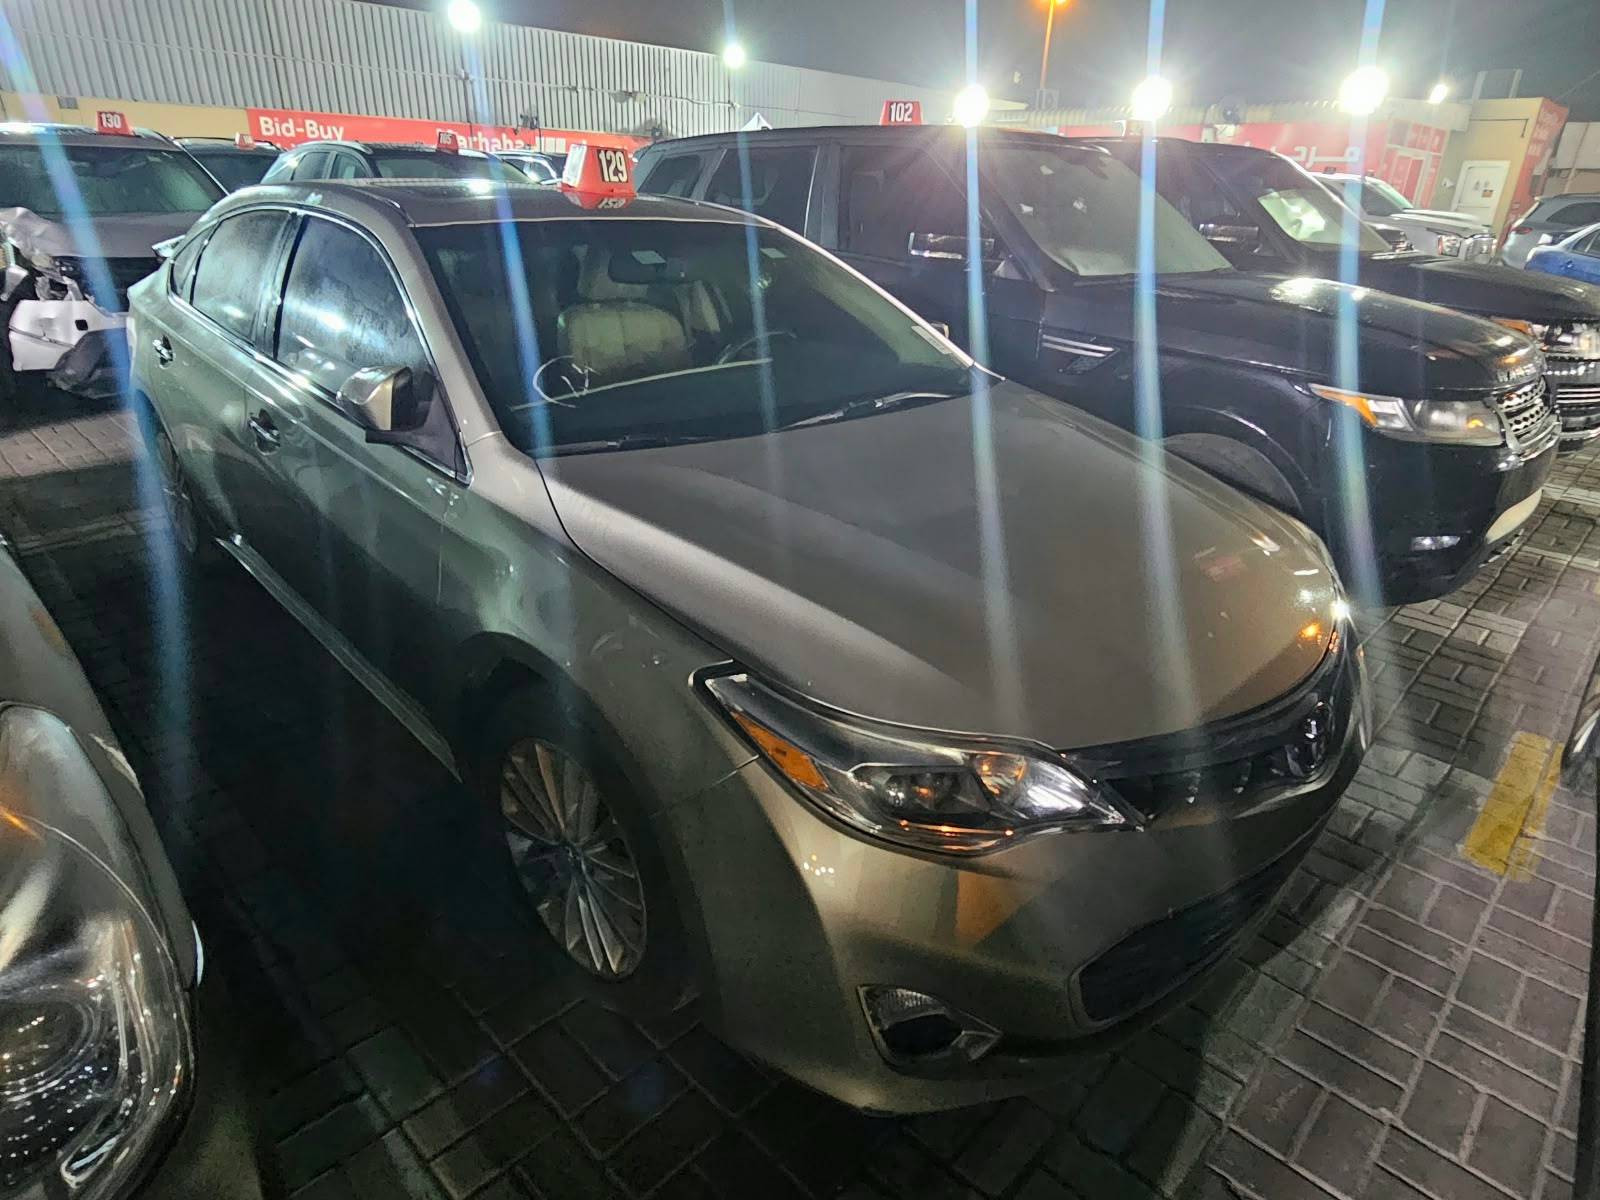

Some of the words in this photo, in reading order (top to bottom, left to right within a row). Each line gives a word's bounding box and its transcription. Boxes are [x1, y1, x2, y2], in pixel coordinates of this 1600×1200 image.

[101, 112, 121, 129] 130
[890, 102, 913, 122] 102
[259, 116, 345, 142] Bid-Buy
[437, 128, 526, 152] arhaba
[598, 149, 628, 183] 129
